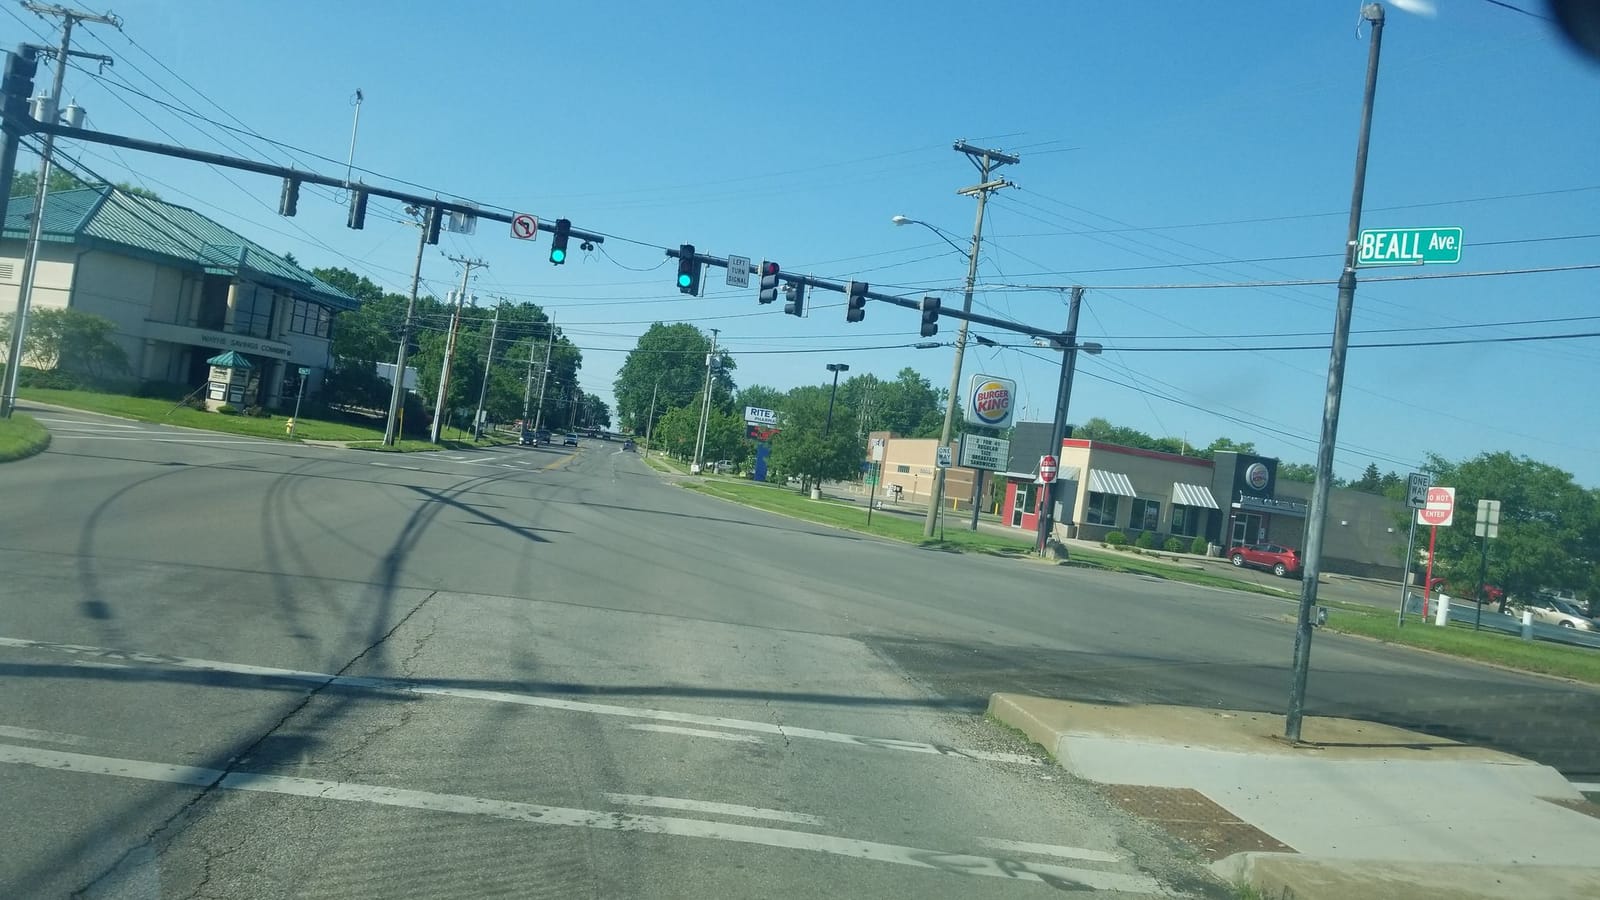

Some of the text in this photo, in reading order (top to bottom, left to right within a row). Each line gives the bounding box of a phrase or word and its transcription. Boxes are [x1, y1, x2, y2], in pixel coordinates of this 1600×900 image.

[1362, 232, 1458, 259] BEALL Ave.
[728, 276, 746, 284] SIGNAL
[977, 390, 1009, 401] BURGER
[978, 398, 1009, 413] KING
[750, 408, 770, 417] RITE
[1413, 476, 1427, 486] ONE
[1412, 487, 1426, 496] WAY
